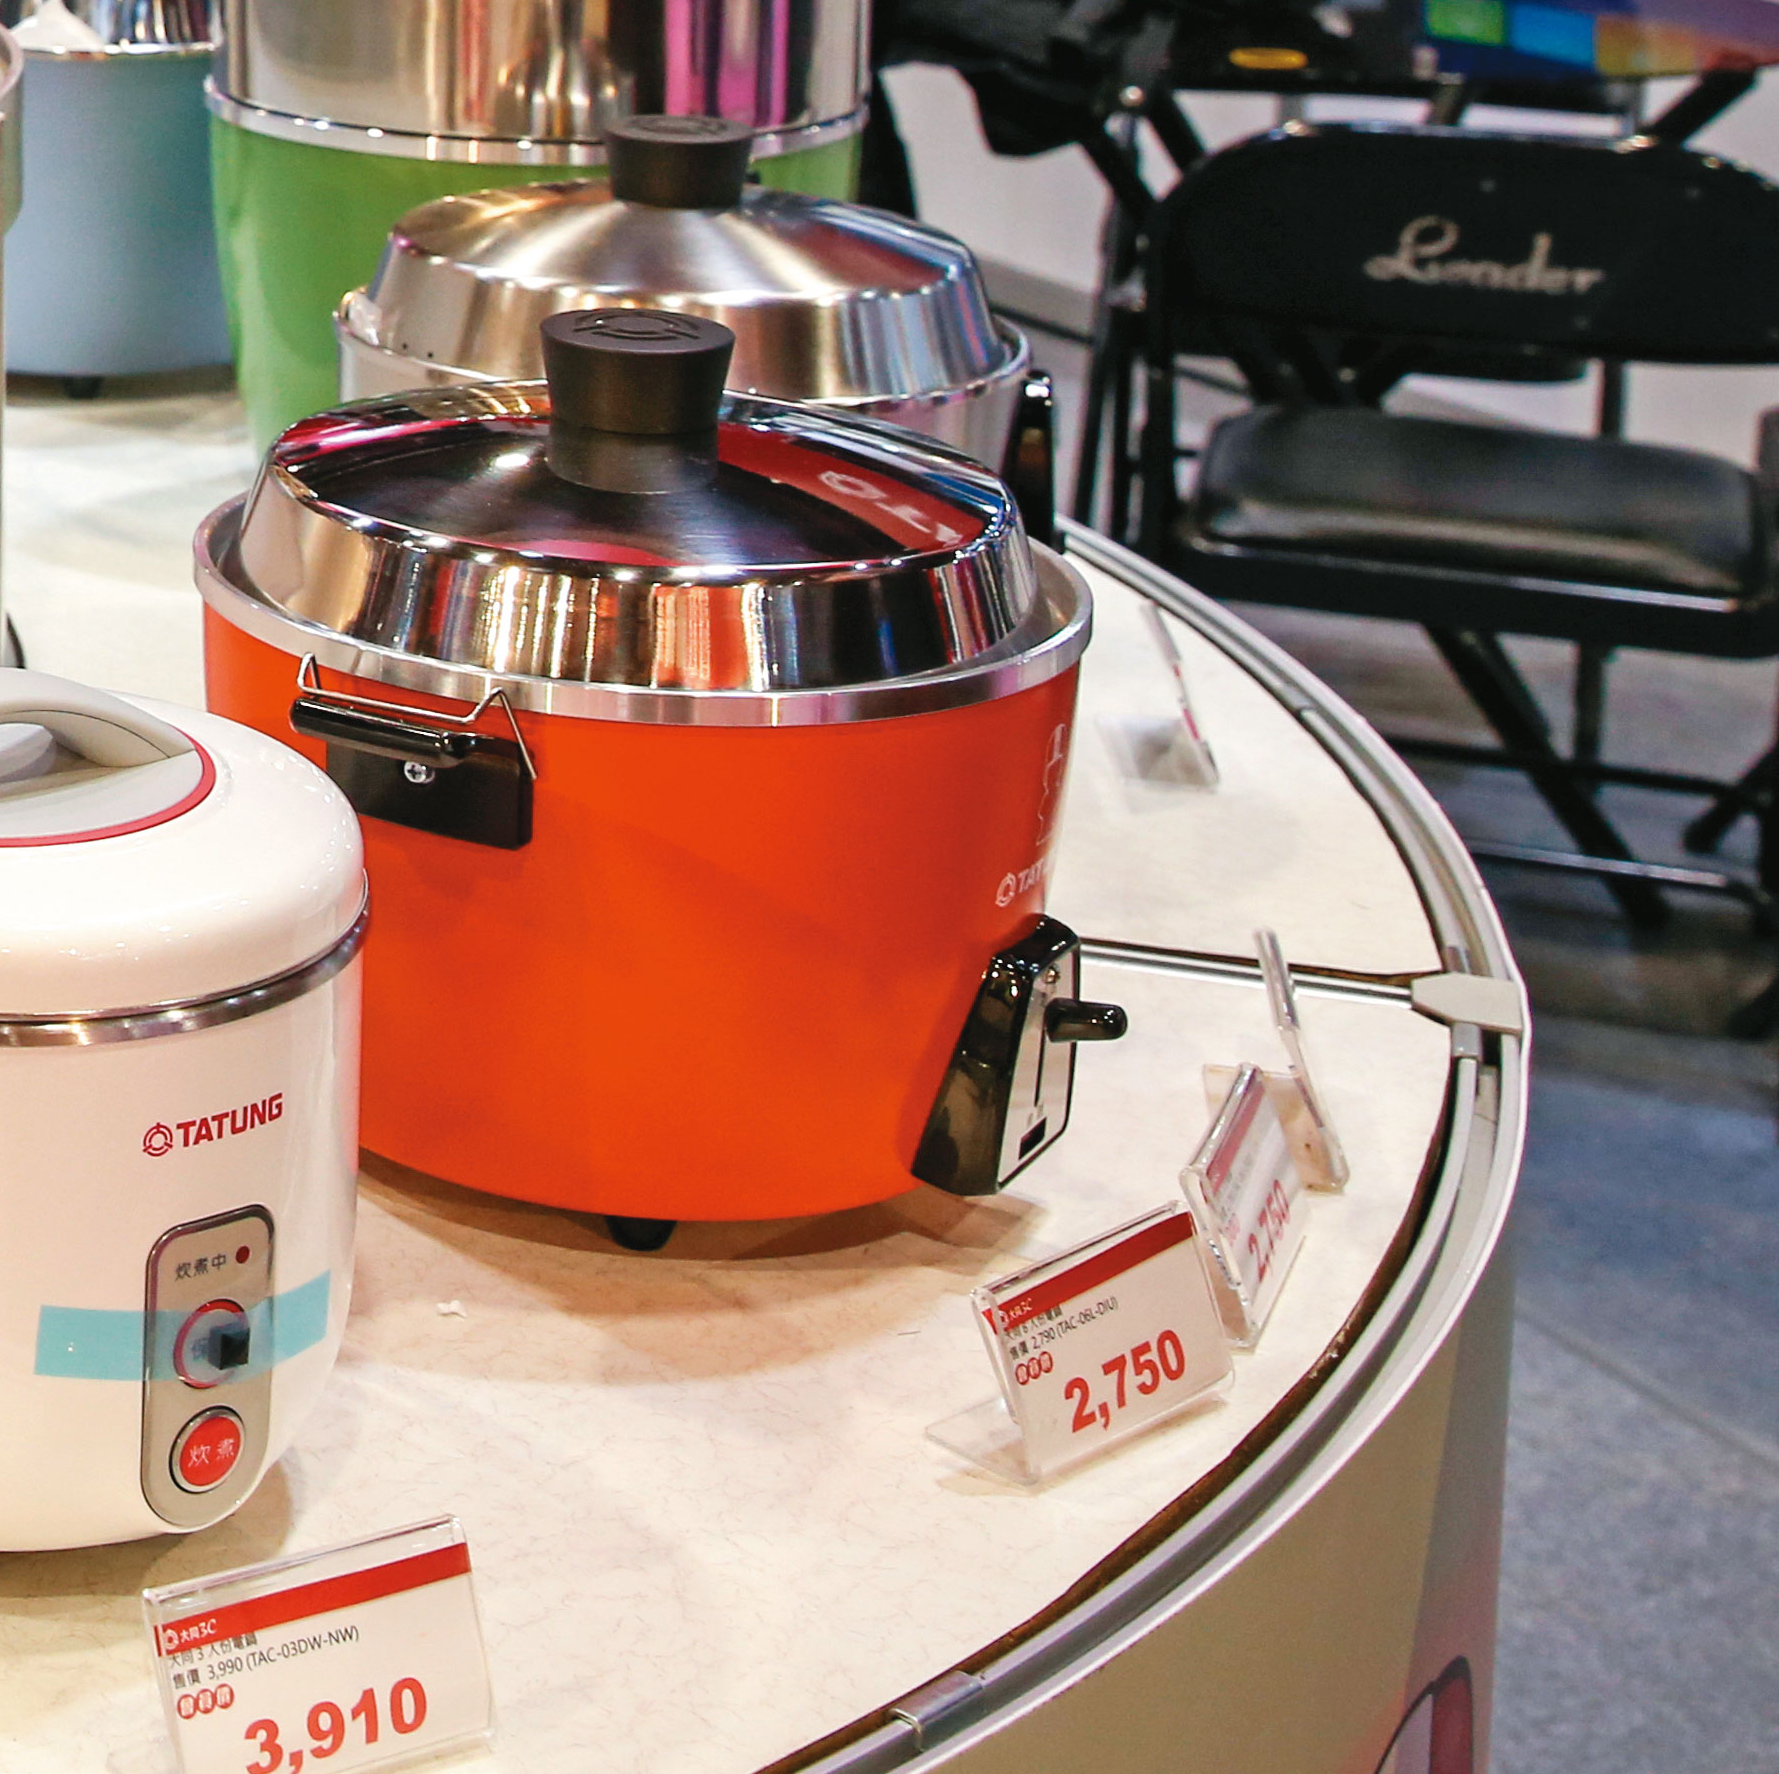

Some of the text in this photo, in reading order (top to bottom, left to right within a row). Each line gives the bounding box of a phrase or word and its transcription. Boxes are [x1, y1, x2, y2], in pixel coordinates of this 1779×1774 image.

[175, 1092, 284, 1149] TATUNG
[174, 1253, 229, 1282] 炊煮中
[1064, 1329, 1186, 1434] 2,750
[207, 1657, 244, 1682] 3,990
[246, 1625, 360, 1674] (TAC-03DW-NW)
[244, 1677, 428, 1774] 3,910
